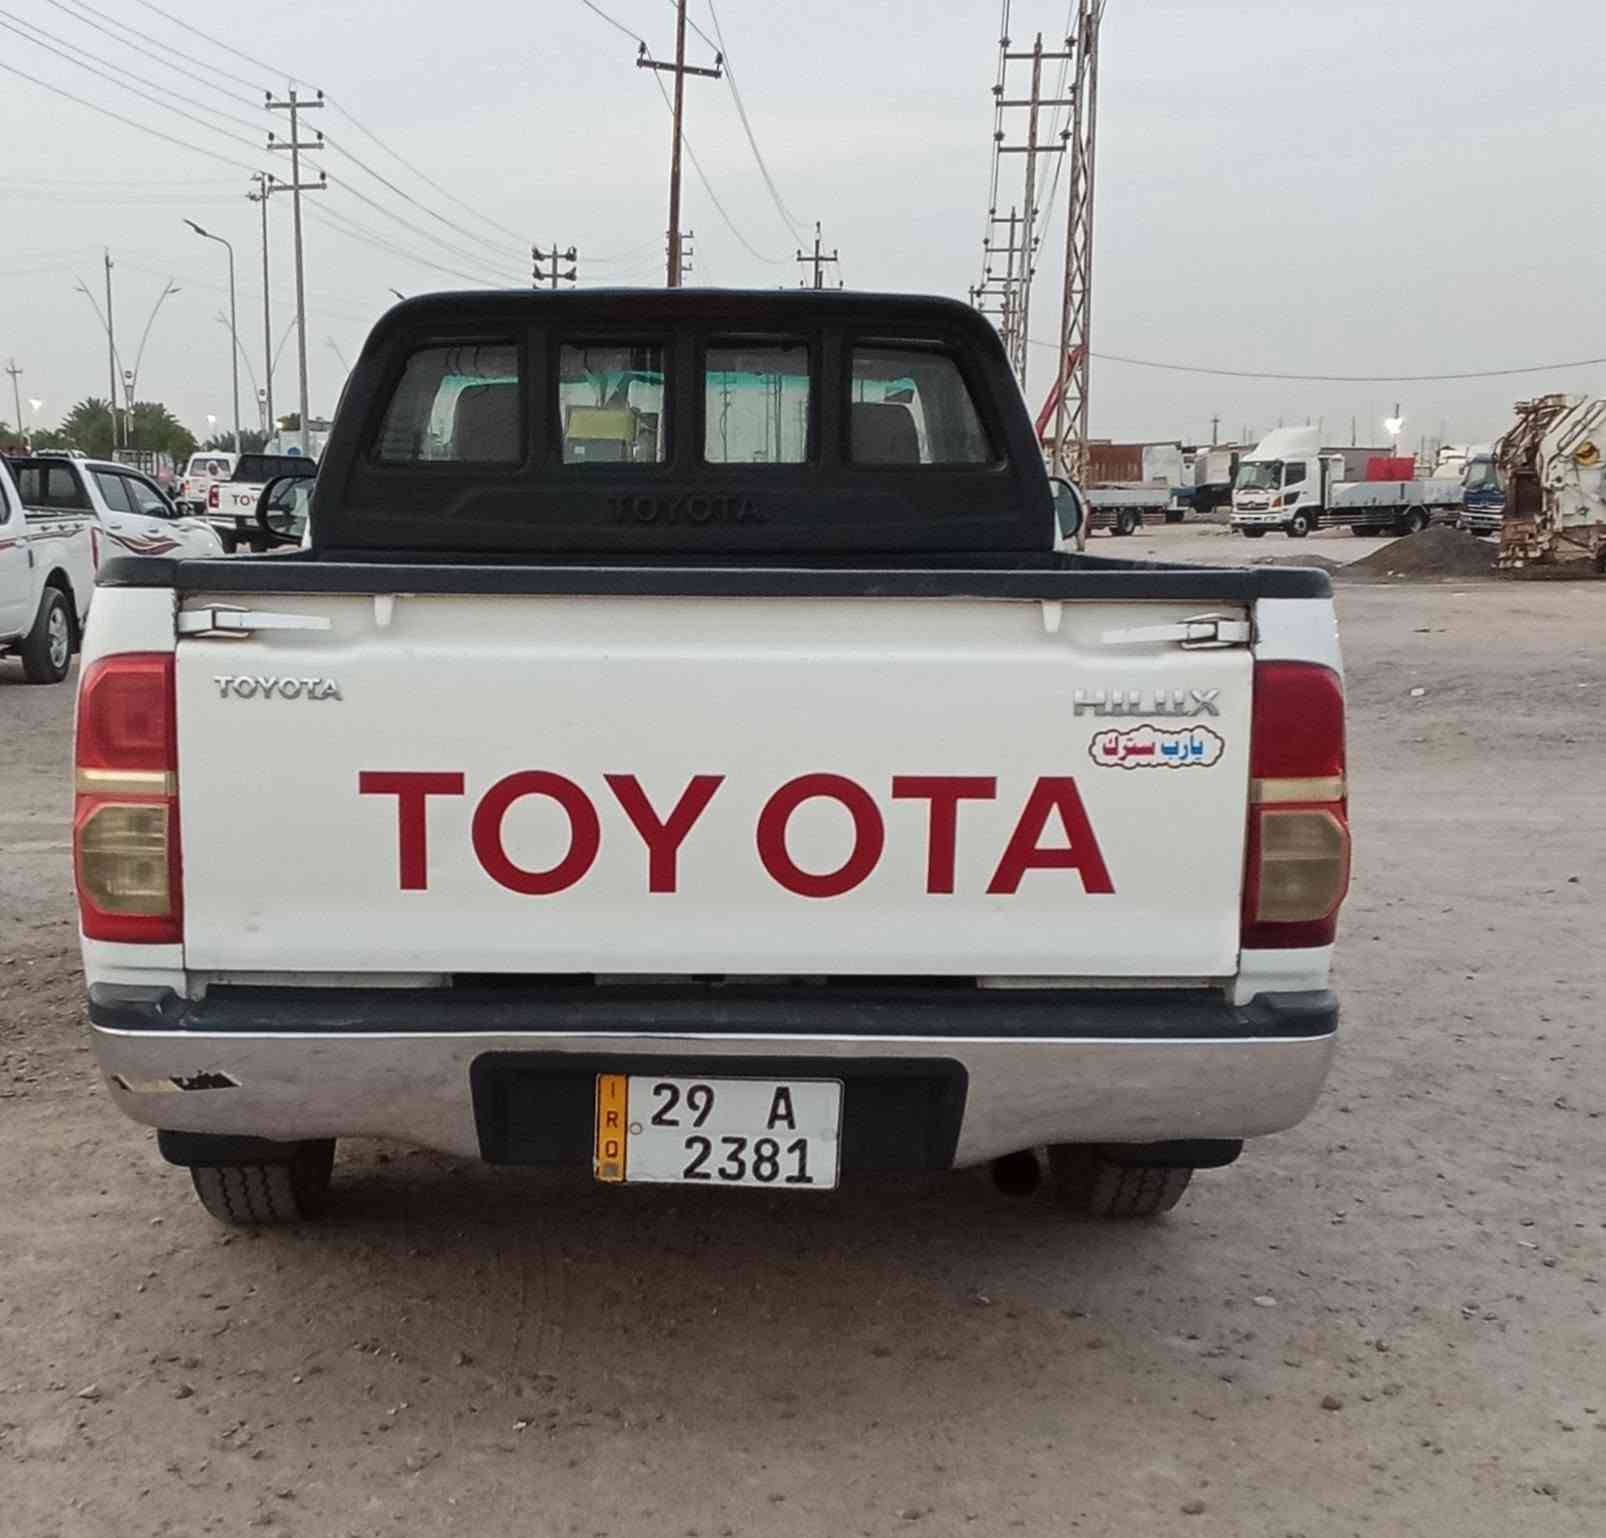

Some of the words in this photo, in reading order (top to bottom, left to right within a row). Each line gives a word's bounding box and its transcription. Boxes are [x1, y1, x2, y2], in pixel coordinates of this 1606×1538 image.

[608, 497, 767, 525] TOYOTA
[213, 675, 343, 702] TOYOTA
[1073, 688, 1220, 717] HILUX
[651, 1082, 715, 1128] 29
[767, 1085, 796, 1130] A
[682, 1135, 813, 1184] 2381
